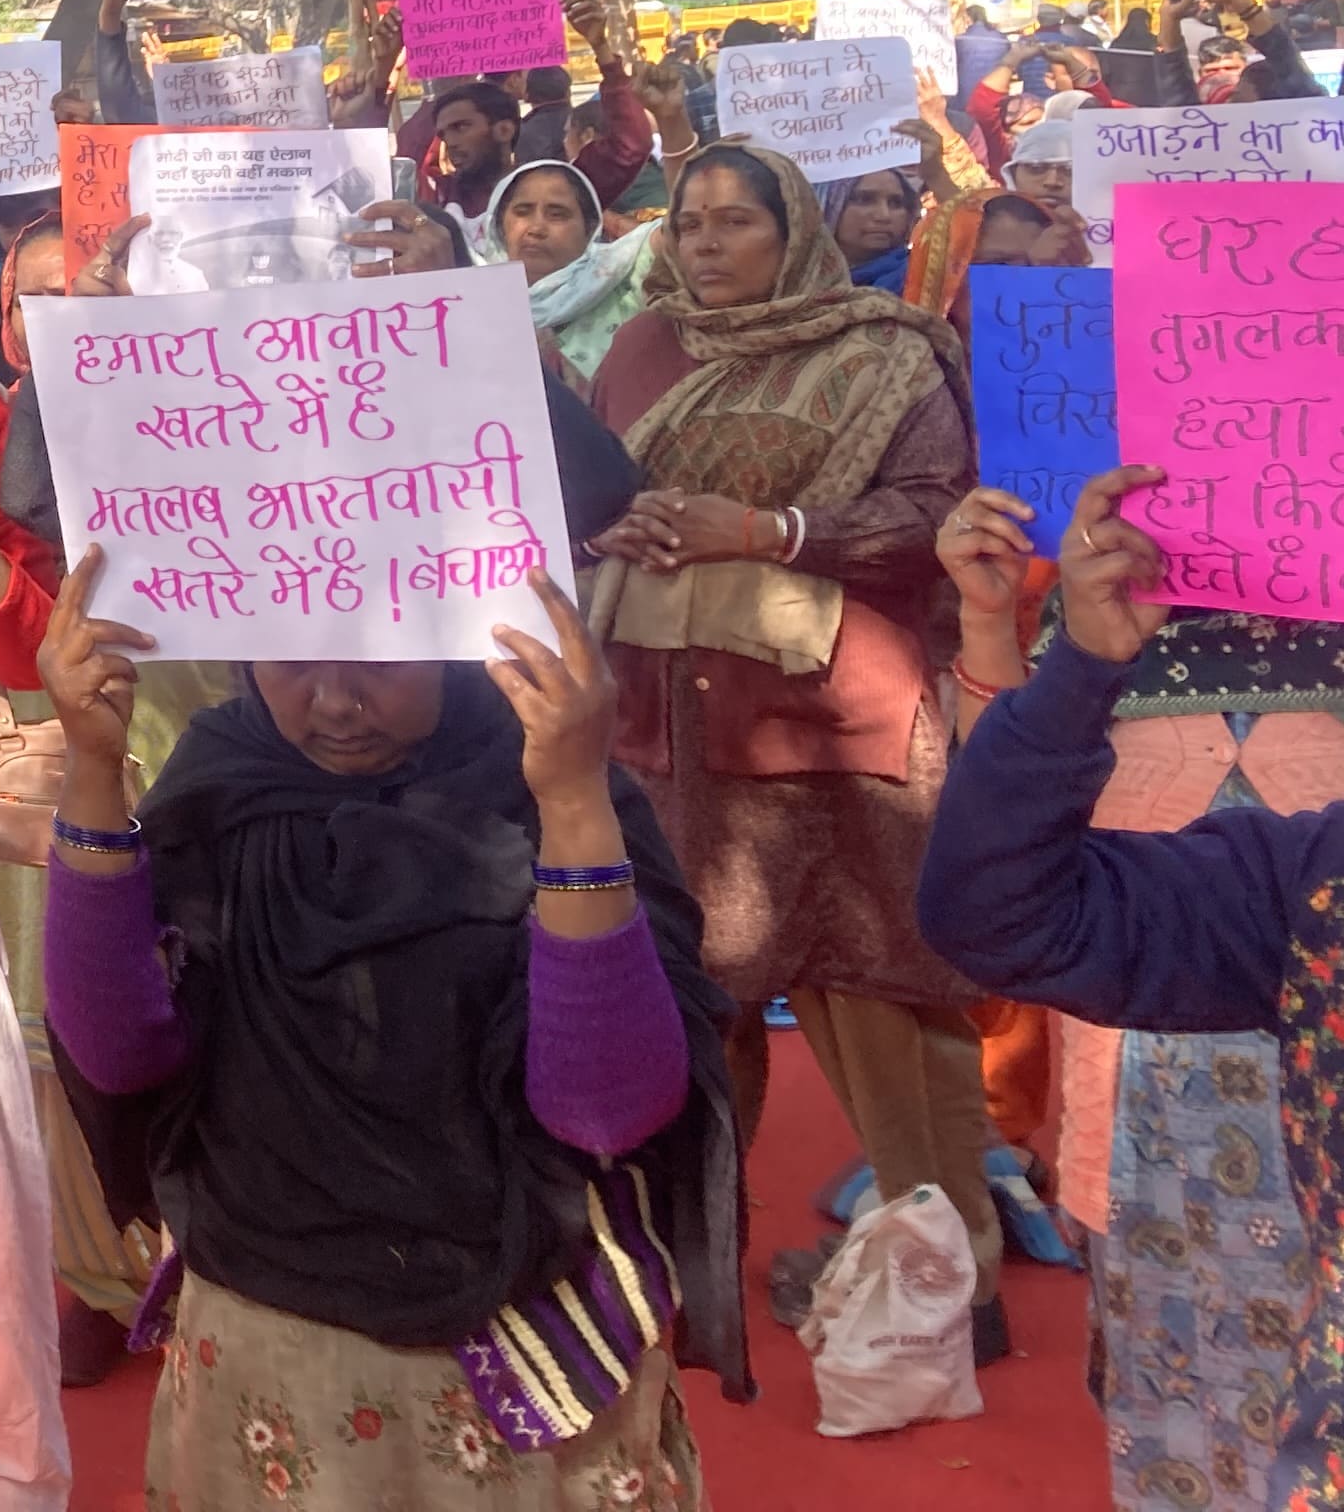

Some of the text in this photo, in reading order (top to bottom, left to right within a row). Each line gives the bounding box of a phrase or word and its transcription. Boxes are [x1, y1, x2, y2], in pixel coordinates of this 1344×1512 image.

[156, 146, 311, 164] मोदी जी का यह ऐलान
[1239, 120, 1300, 154] का
[191, 165, 232, 185] झुग्गी
[266, 166, 312, 179] मकान
[1157, 215, 1283, 286] घर
[73, 294, 464, 386] हमारा आवास
[135, 360, 396, 453] खतरे में है
[1172, 396, 1331, 460] हत्या
[86, 420, 525, 539] मतलब भारतवासी
[132, 536, 258, 619] खतरे
[259, 543, 321, 615] में
